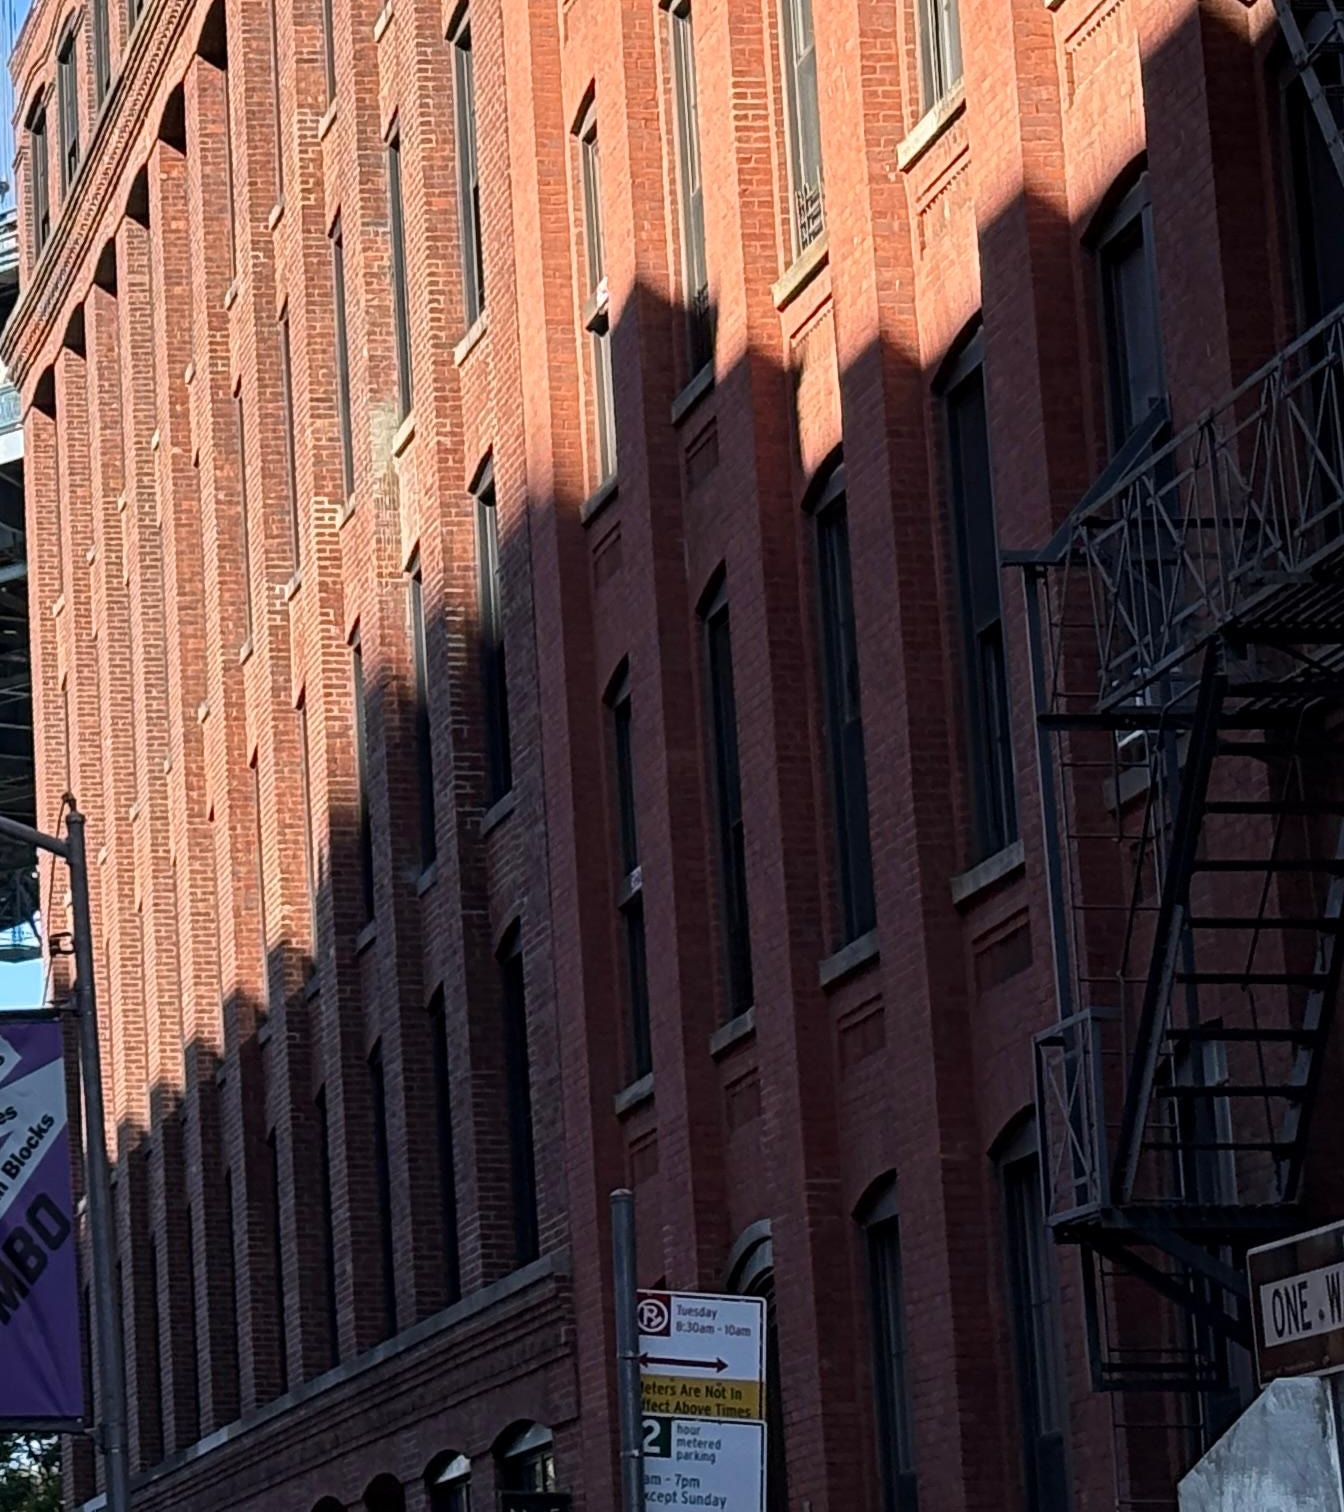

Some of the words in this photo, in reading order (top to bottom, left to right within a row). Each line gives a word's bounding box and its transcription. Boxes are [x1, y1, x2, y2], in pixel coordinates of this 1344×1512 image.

[1, 1114, 54, 1180] Blocks
[676, 1304, 718, 1320] Tuesday
[1272, 1280, 1311, 1338] ONE
[676, 1321, 715, 1335] 8:30am
[724, 1324, 752, 1337] 10am
[680, 1384, 701, 1398] Are
[705, 1385, 727, 1400] Not
[730, 1388, 742, 1400] In
[641, 1397, 670, 1412] ffect
[674, 1400, 711, 1416] Above
[716, 1403, 751, 1417] Times
[641, 1419, 661, 1454] 2
[676, 1423, 701, 1435] hour
[676, 1437, 722, 1450] metered
[676, 1450, 716, 1465] parking
[674, 1474, 700, 1490] 7pm
[643, 1490, 677, 1505] xcept
[681, 1491, 727, 1509] Sunday
